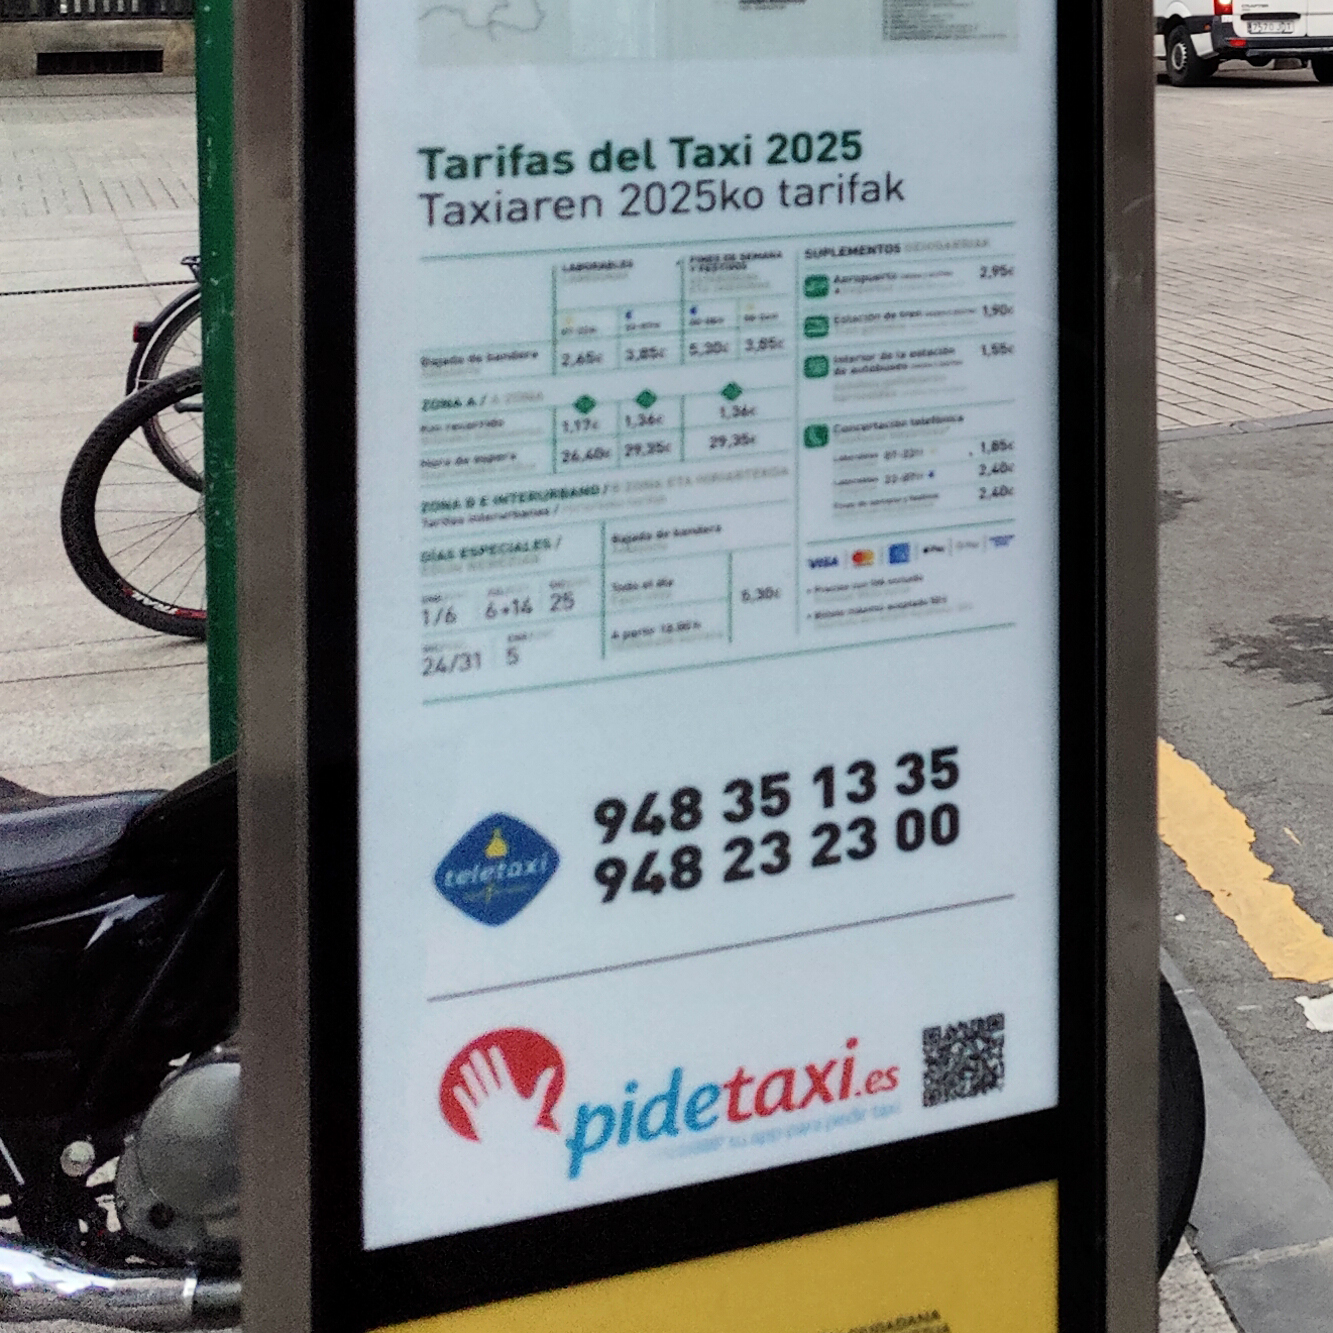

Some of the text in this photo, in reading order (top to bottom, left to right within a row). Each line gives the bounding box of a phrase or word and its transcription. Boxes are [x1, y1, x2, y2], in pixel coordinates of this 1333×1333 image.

[418, 129, 864, 182] Tarifas del Taxi 2025
[419, 171, 906, 228] Taxiaren 2025ko tarifak
[804, 243, 901, 261] SUPLEMENTOS
[594, 745, 961, 846] 948 35 13 35
[444, 852, 549, 887] teletaxi
[594, 802, 961, 904] 948 23 23 00
[565, 1036, 900, 1181] pidetaxi.es
